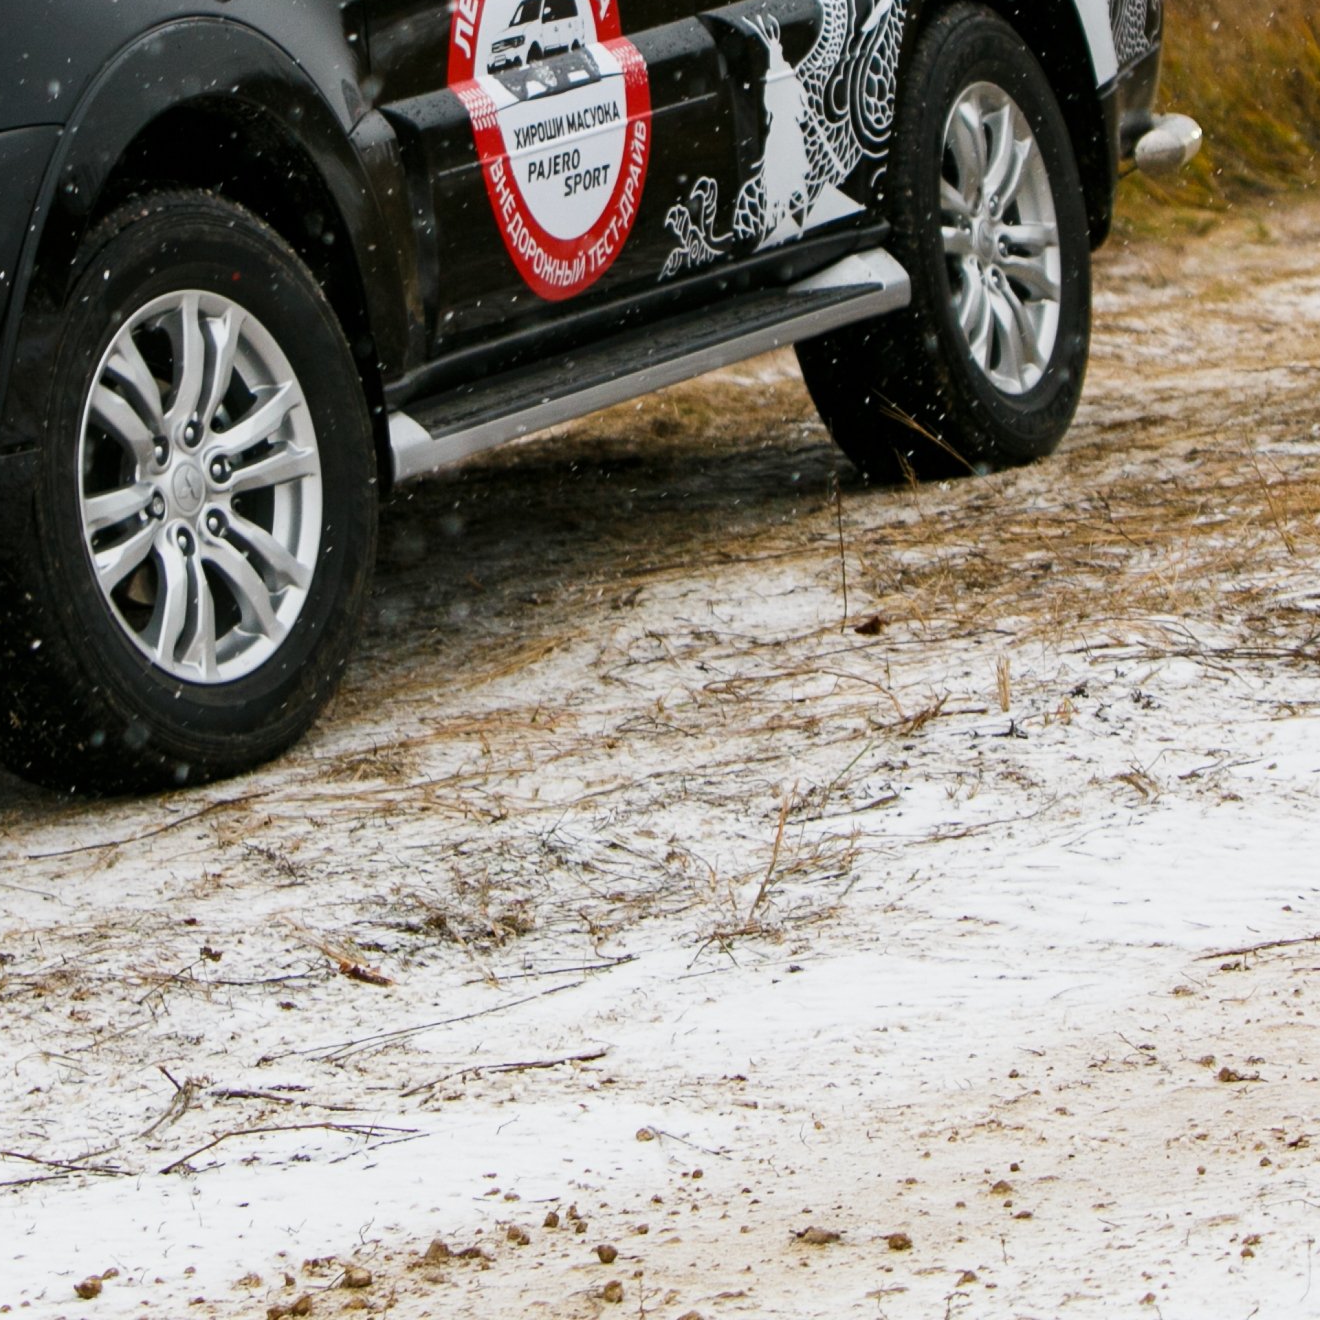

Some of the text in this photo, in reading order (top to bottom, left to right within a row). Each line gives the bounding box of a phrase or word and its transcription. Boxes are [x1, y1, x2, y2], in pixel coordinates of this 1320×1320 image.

[513, 101, 621, 150] ХИРОШИ МАСУОКА
[528, 148, 580, 183] PAJERO
[564, 164, 611, 197] SPORT
[489, 120, 647, 288] ВНЕДОРОЖНЫЙ ТЕСТ-ДРАЙВ
